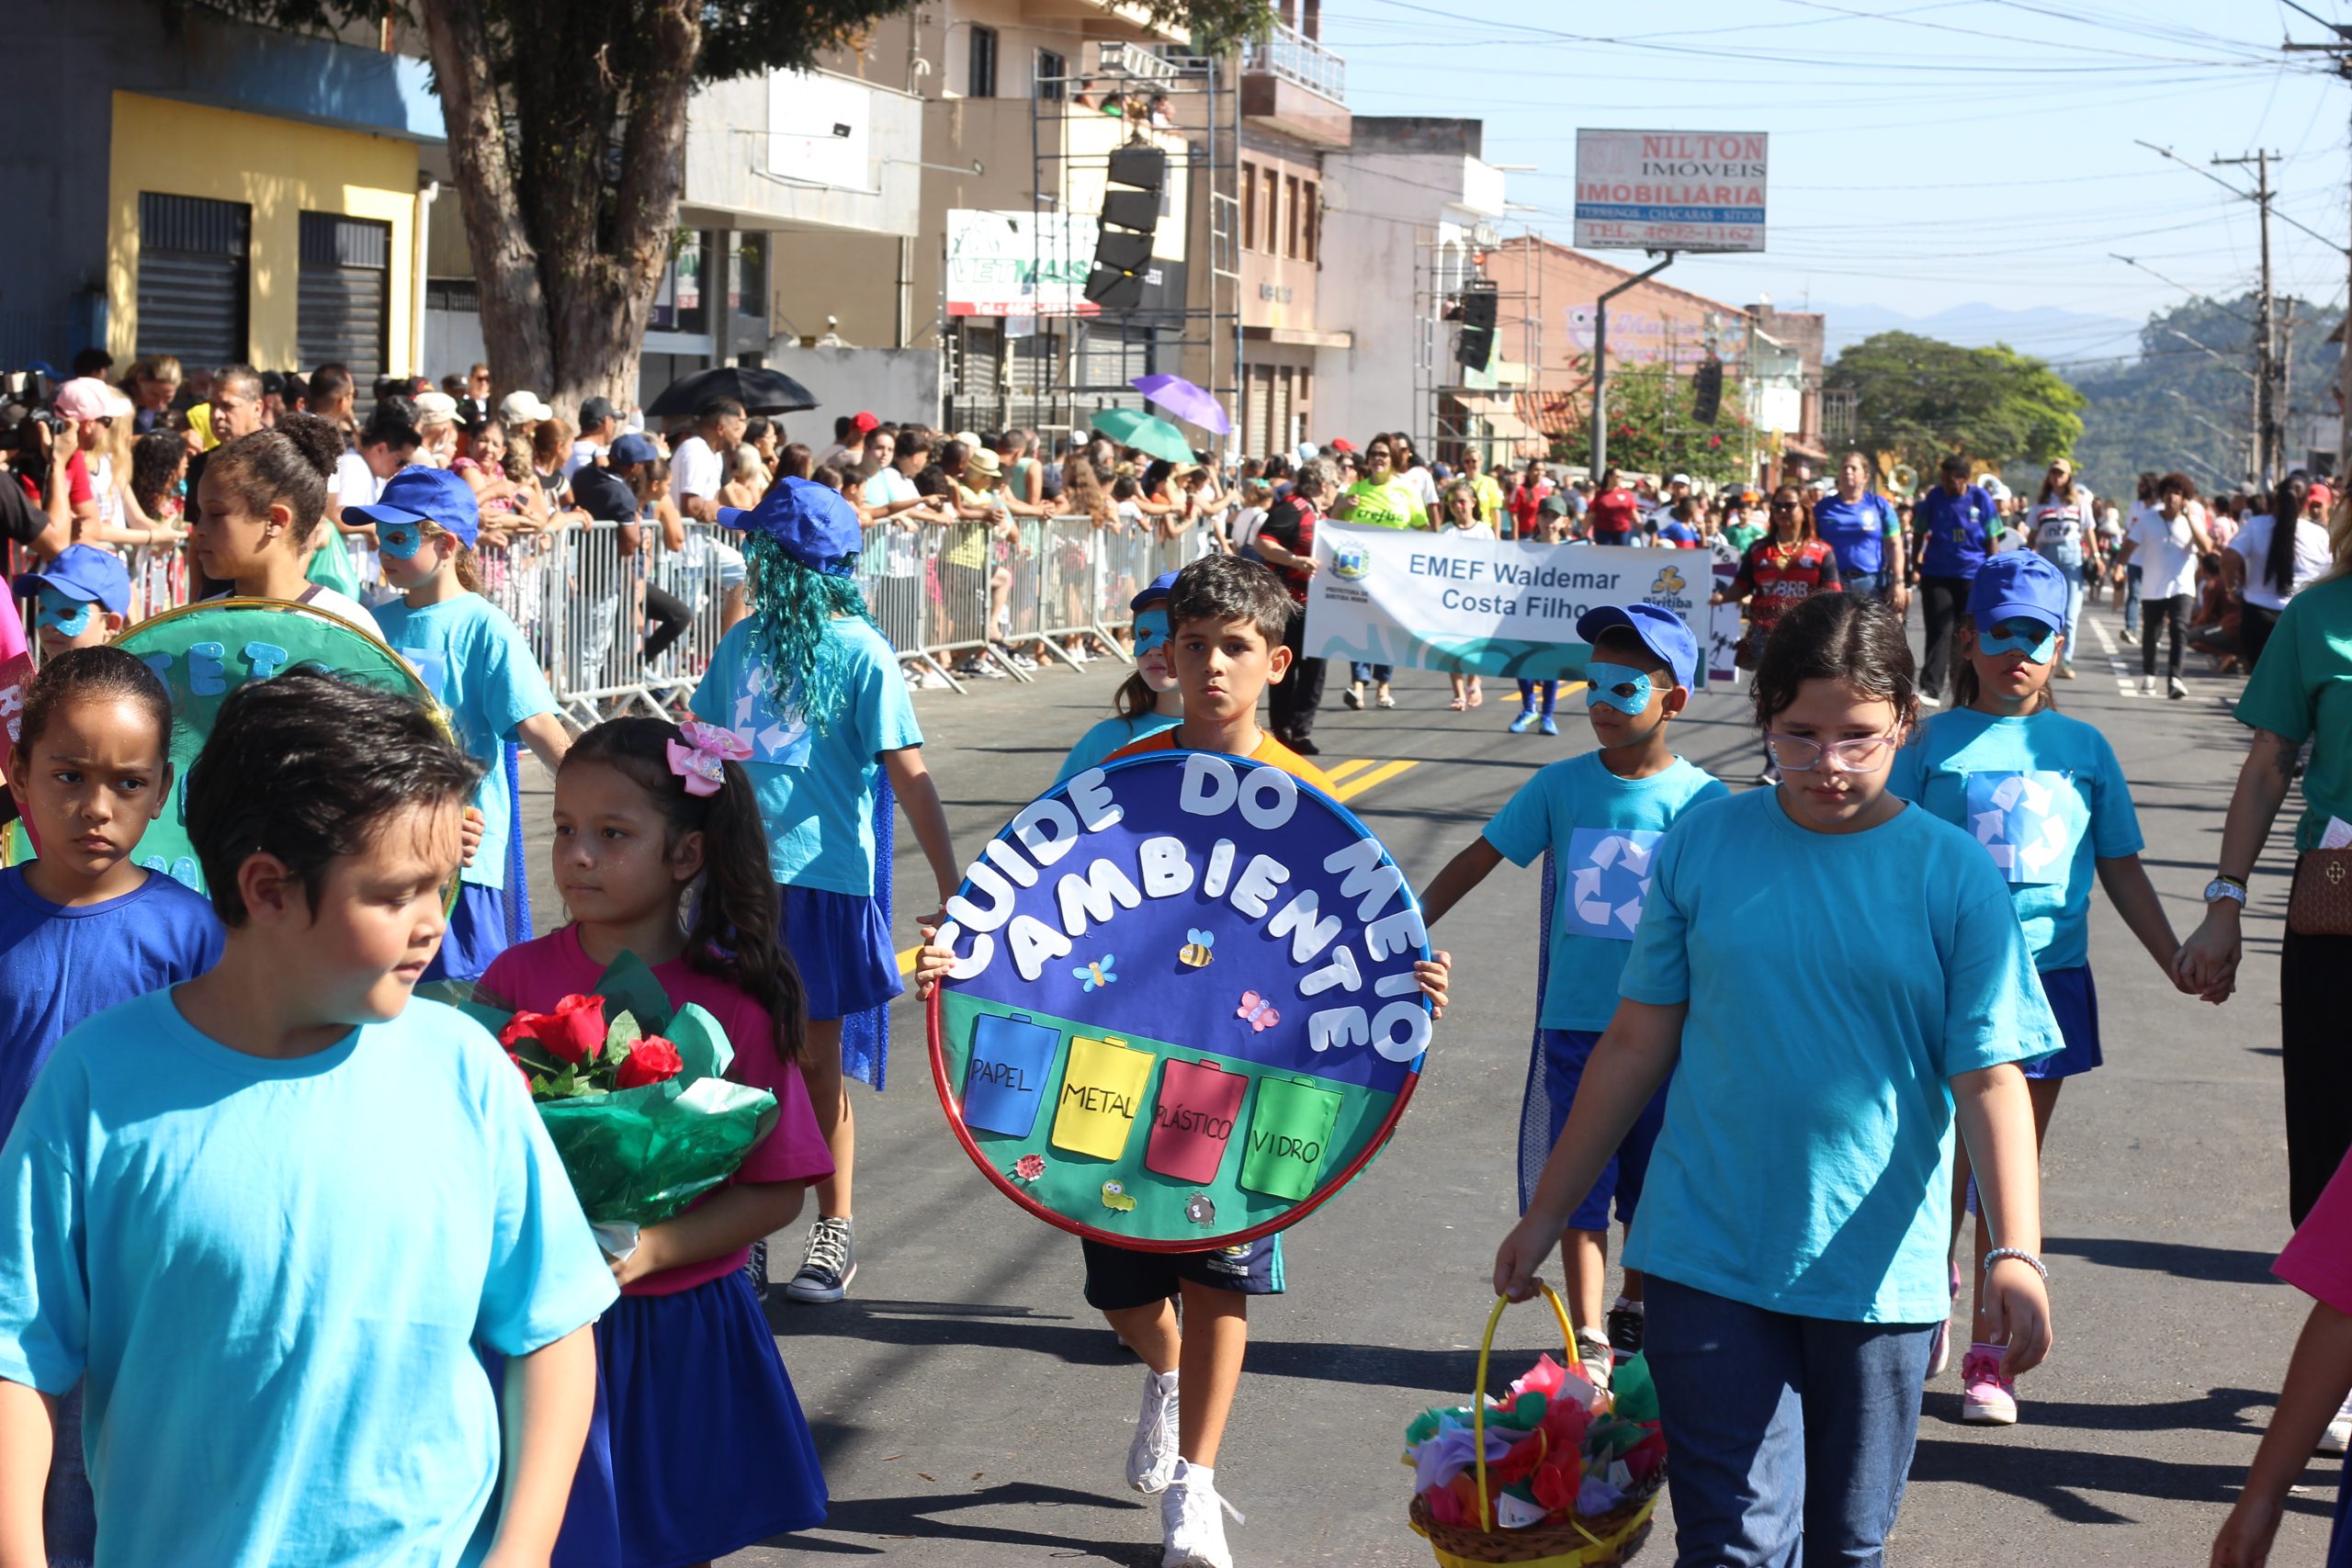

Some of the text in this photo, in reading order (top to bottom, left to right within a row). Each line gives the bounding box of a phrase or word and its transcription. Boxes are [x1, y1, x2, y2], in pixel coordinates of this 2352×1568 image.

[1641, 135, 1763, 161] NILTON
[1642, 162, 1766, 177] IMÓVEIS
[1577, 183, 1764, 205] IMOBILIÁRIA
[1409, 554, 1621, 590] EMEF Waldemar
[1774, 580, 1808, 597] BRB
[1442, 589, 1589, 619] Costa Filho
[933, 753, 1432, 1062] CUIDE DO MEIO
[1008, 836, 1370, 1052] AMBIENTE
[970, 1058, 1033, 1091] PAPEL
[1063, 1083, 1134, 1119] METAL
[1154, 1103, 1232, 1140] PLÁSTICO
[1254, 1130, 1319, 1163] VIDRO
